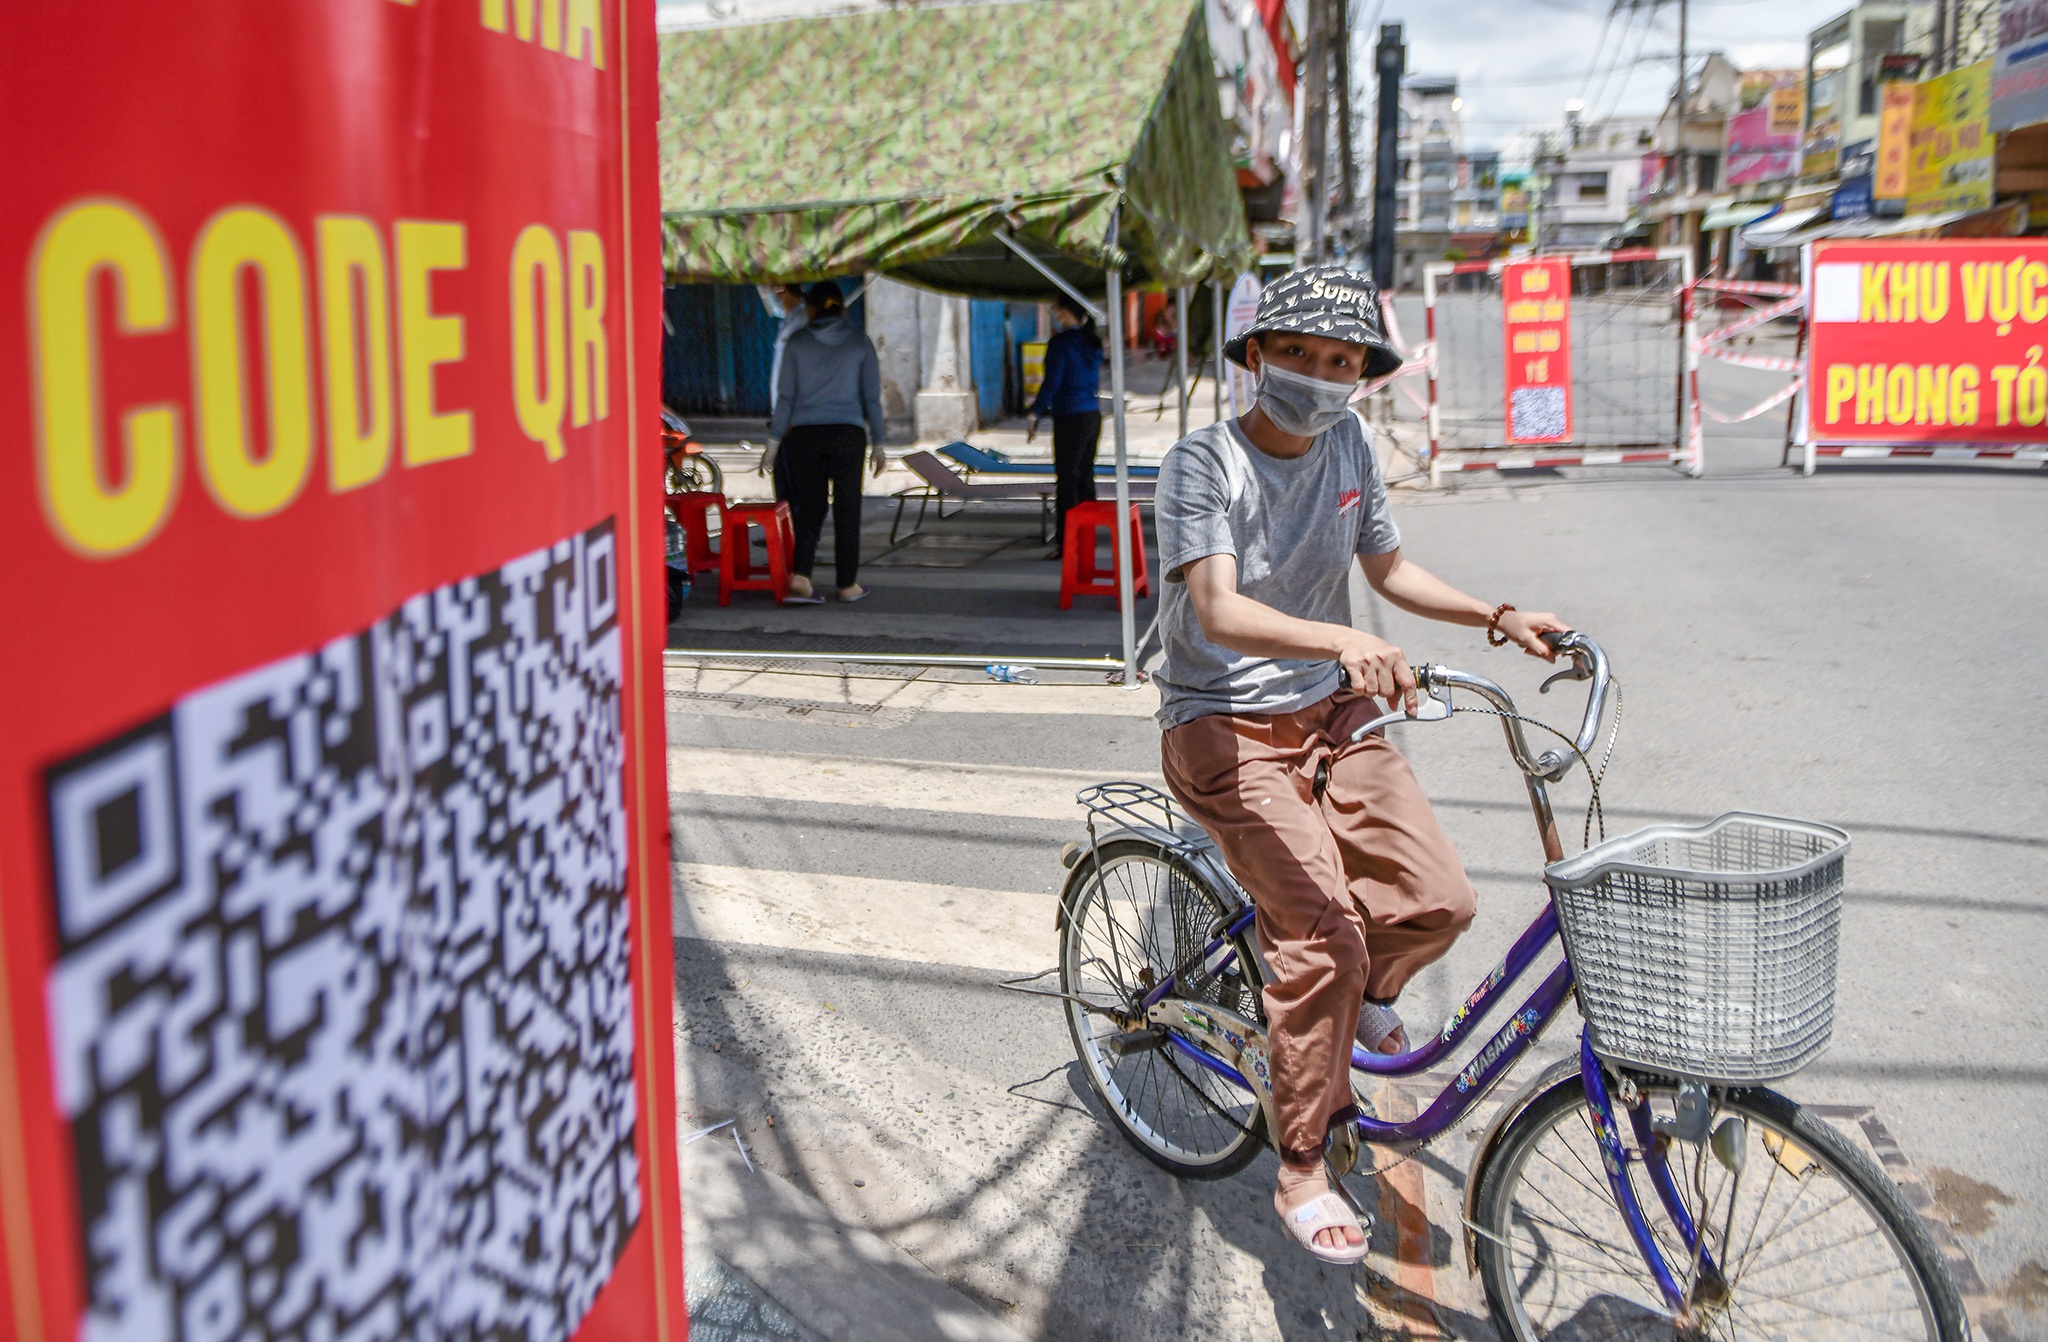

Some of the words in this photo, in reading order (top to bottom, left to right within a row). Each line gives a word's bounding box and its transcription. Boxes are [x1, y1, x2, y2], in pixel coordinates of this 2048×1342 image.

[1859, 261, 1951, 323] KHU
[1960, 255, 2048, 336] VỰC
[28, 195, 476, 558] CODE
[510, 222, 610, 462] QR
[1826, 363, 1980, 426] PHONG
[1991, 343, 2048, 428] TỎ
[1467, 1022, 1518, 1084] NASAKI
